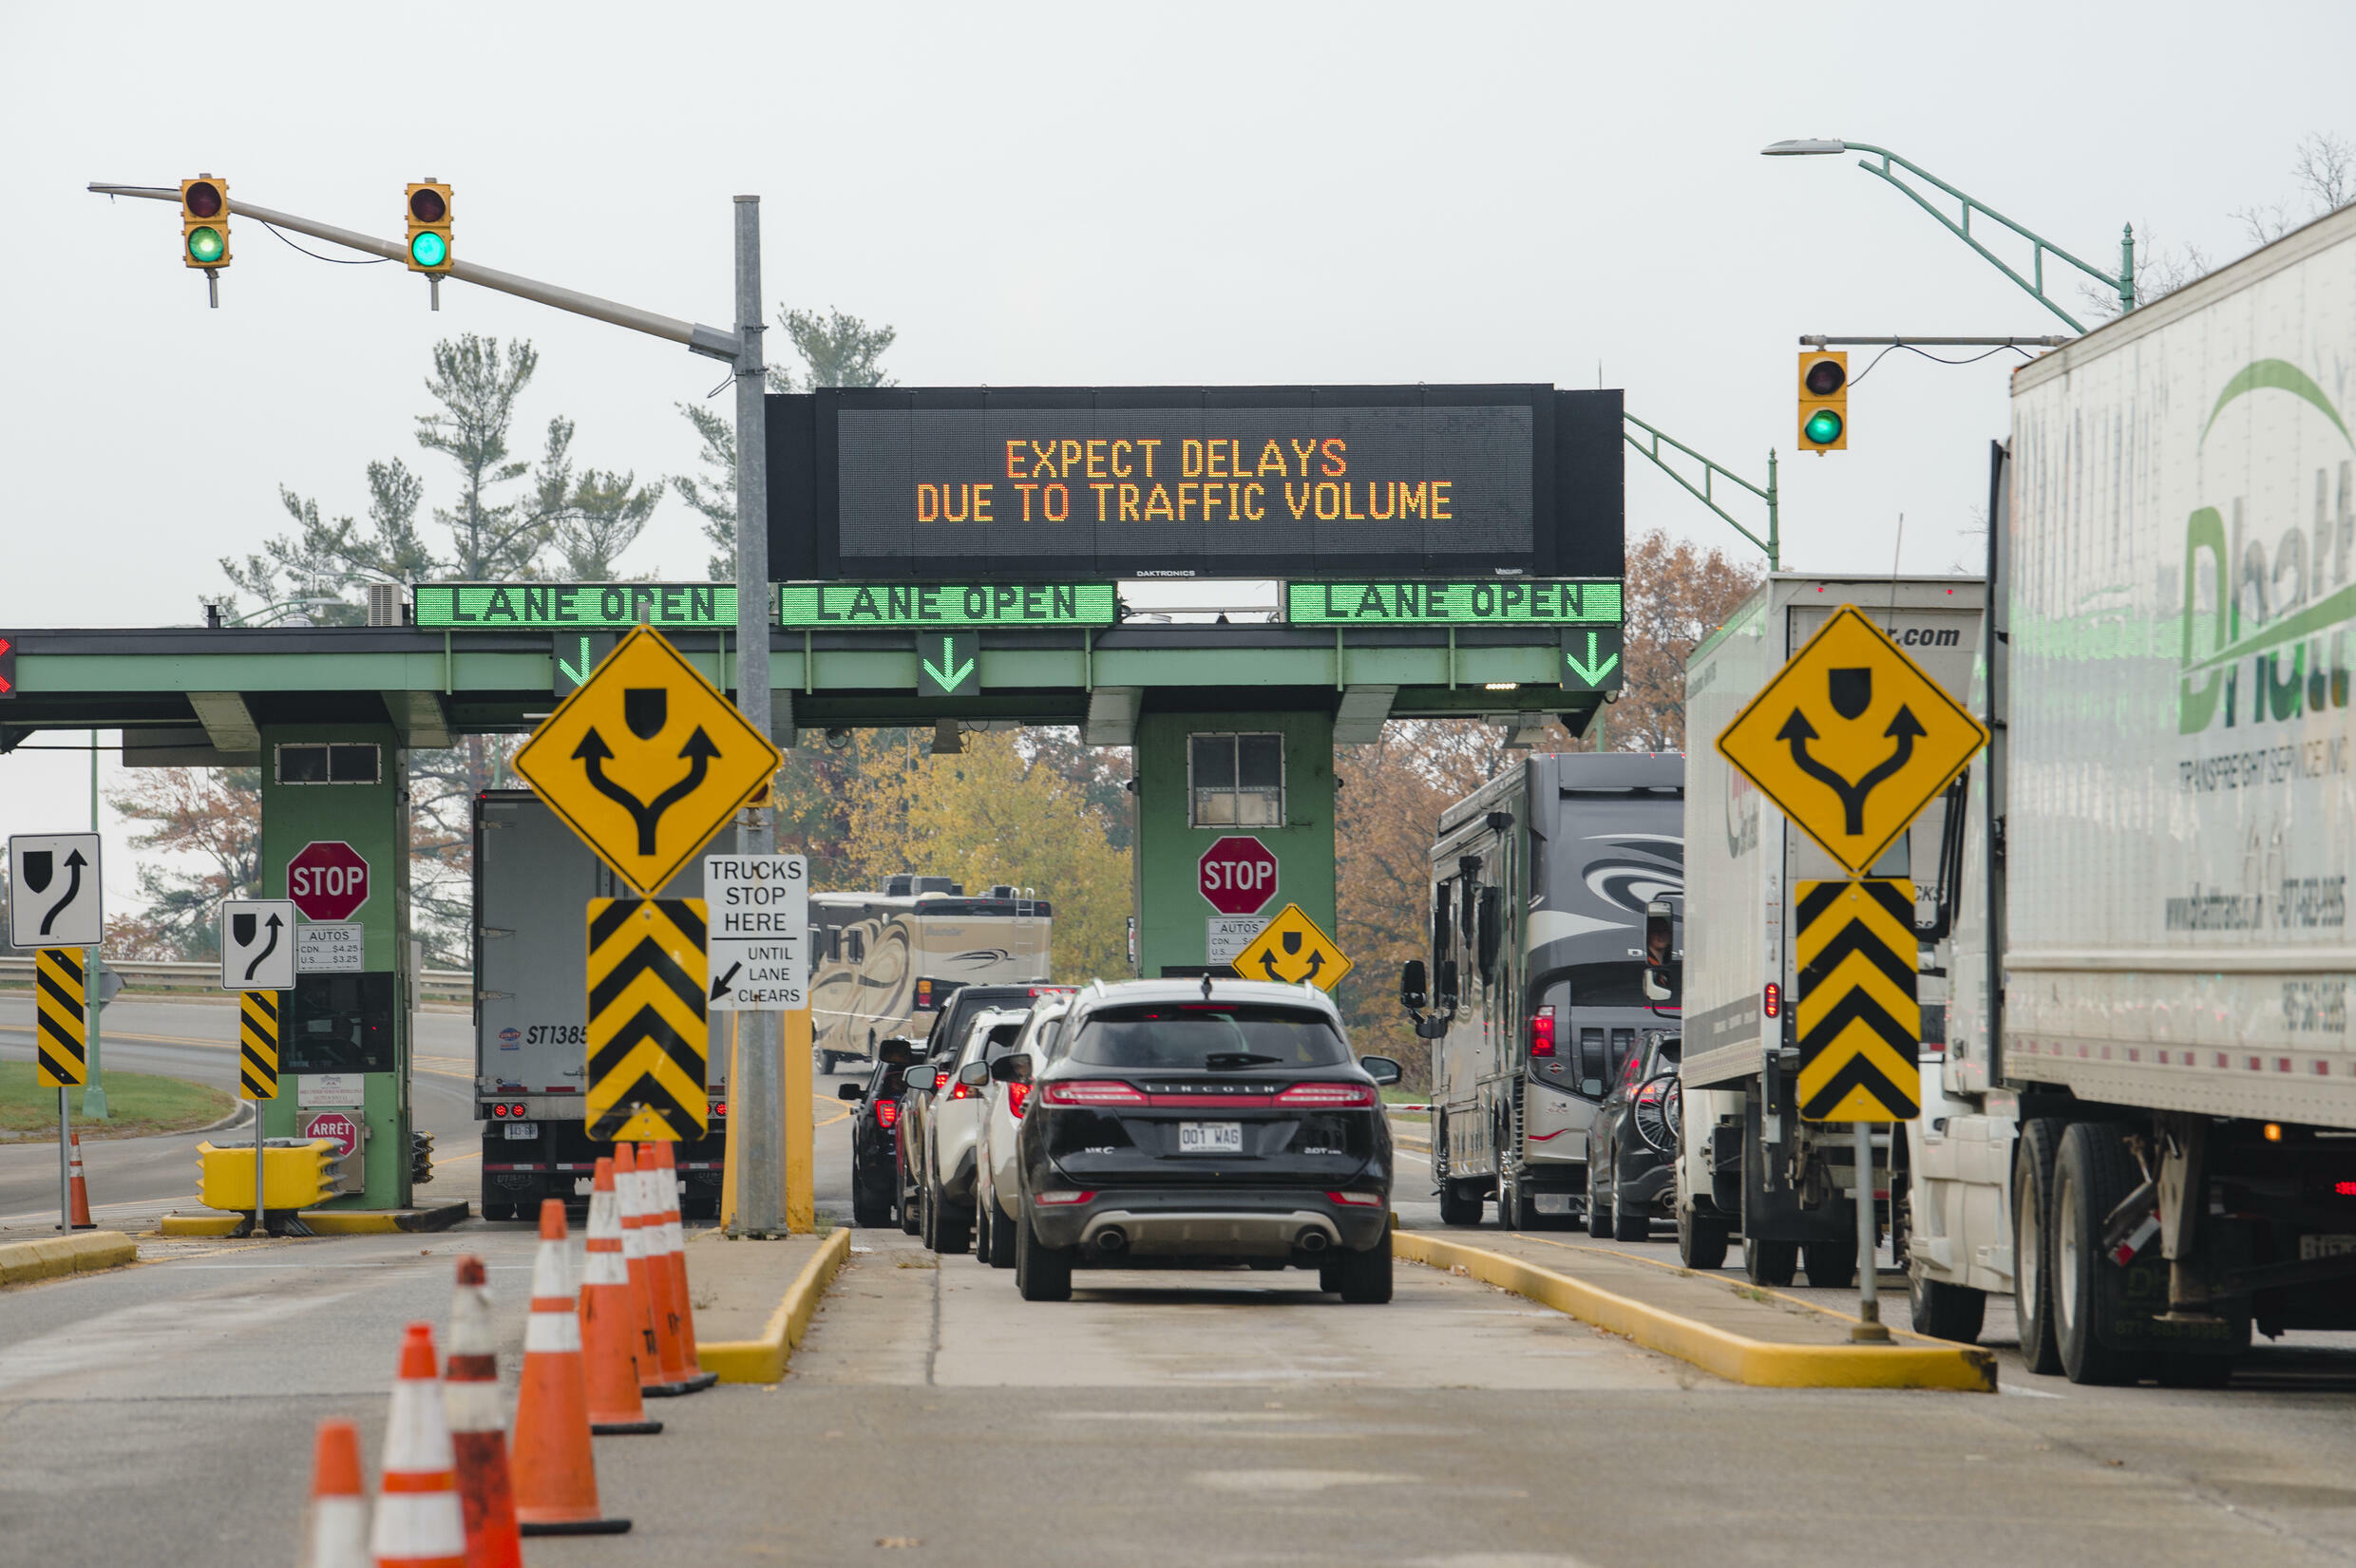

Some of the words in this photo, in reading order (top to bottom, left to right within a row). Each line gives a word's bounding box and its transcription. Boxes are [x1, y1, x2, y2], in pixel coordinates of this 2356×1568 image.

[1006, 440, 1162, 479] EXPECT
[1182, 439, 1346, 477] DELAYS
[918, 483, 994, 522] DUE
[1014, 482, 1070, 521] TO
[1089, 482, 1264, 521] TRAFFIC
[1284, 482, 1453, 520] VOLUME
[452, 588, 579, 621] LANE
[601, 588, 715, 621] OPEN
[818, 587, 941, 619] LANE
[963, 587, 1075, 619] OPEN
[1325, 585, 1450, 617] LANE
[1472, 584, 1583, 617] OPEN
[710, 860, 802, 879] TRUCKS
[1205, 860, 1273, 890] STOP
[293, 866, 364, 897] STOP
[726, 886, 786, 905] STOP
[725, 913, 787, 932] HERE
[1220, 924, 1259, 934] AUTOS
[309, 931, 350, 940] AUTOS
[748, 947, 793, 960] UNTIL
[749, 968, 790, 981] LANE
[738, 989, 801, 1002] CLEARS
[313, 1122, 351, 1135] ARRÊT
[1182, 1128, 1206, 1144] 001
